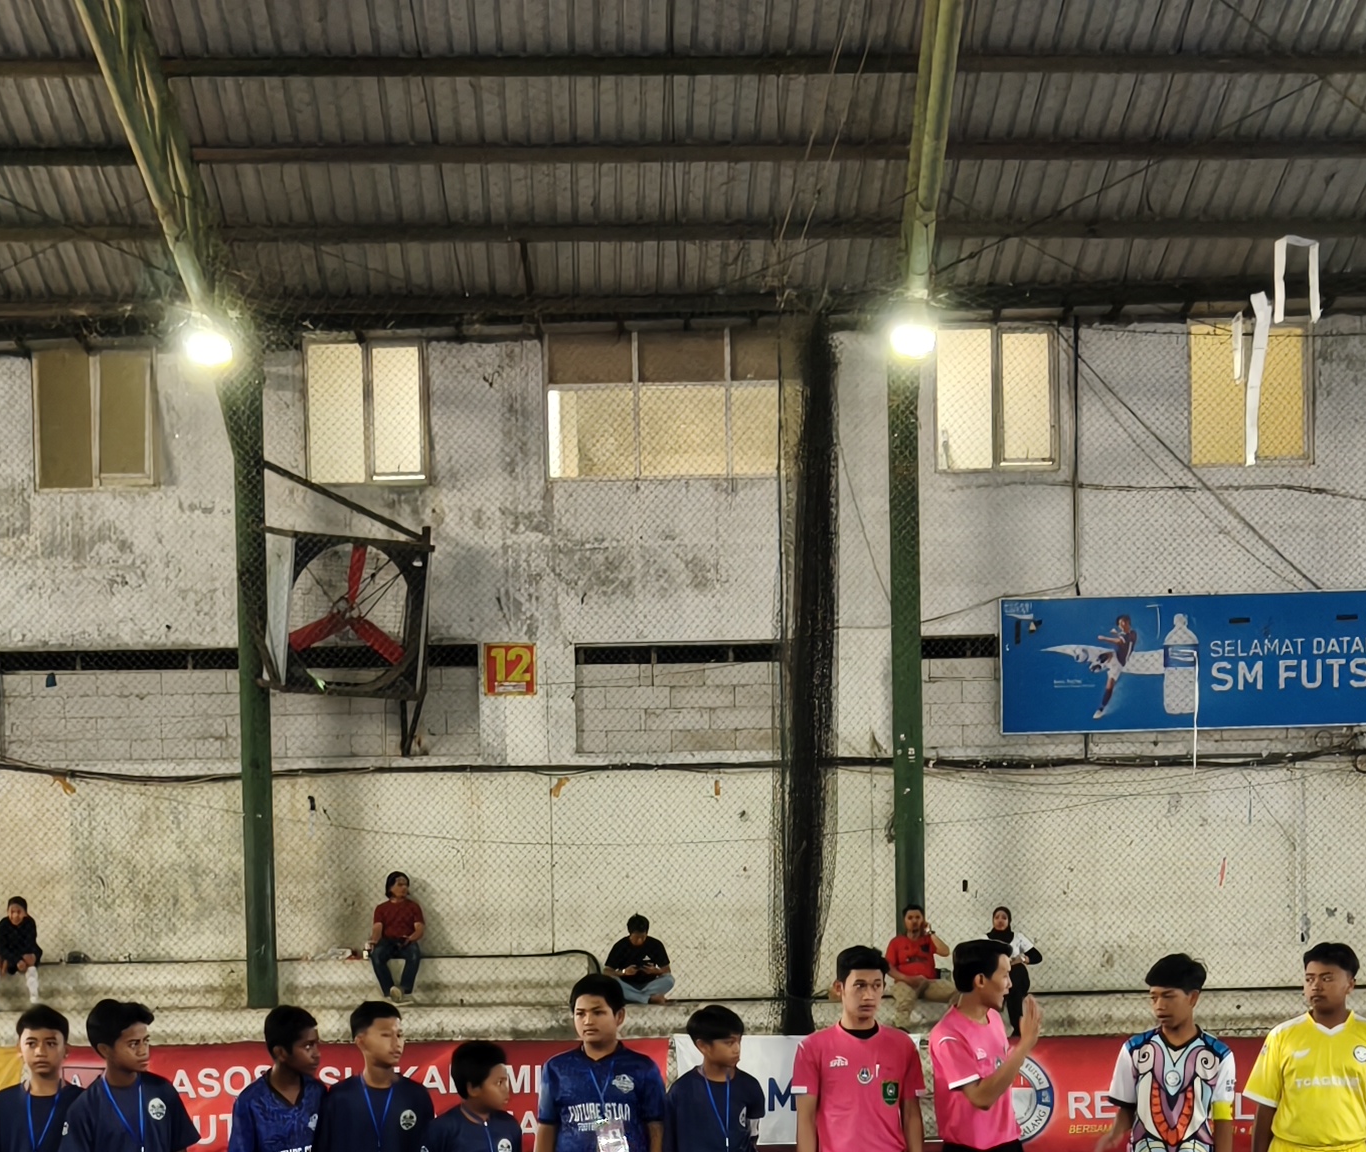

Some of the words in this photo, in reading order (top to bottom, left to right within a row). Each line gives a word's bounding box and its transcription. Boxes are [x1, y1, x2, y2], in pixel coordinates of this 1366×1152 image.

[1210, 638, 1305, 657] SELAMAT
[490, 647, 531, 682] 12
[1211, 660, 1263, 691] SM
[1068, 1124, 1113, 1134] BERSAM
